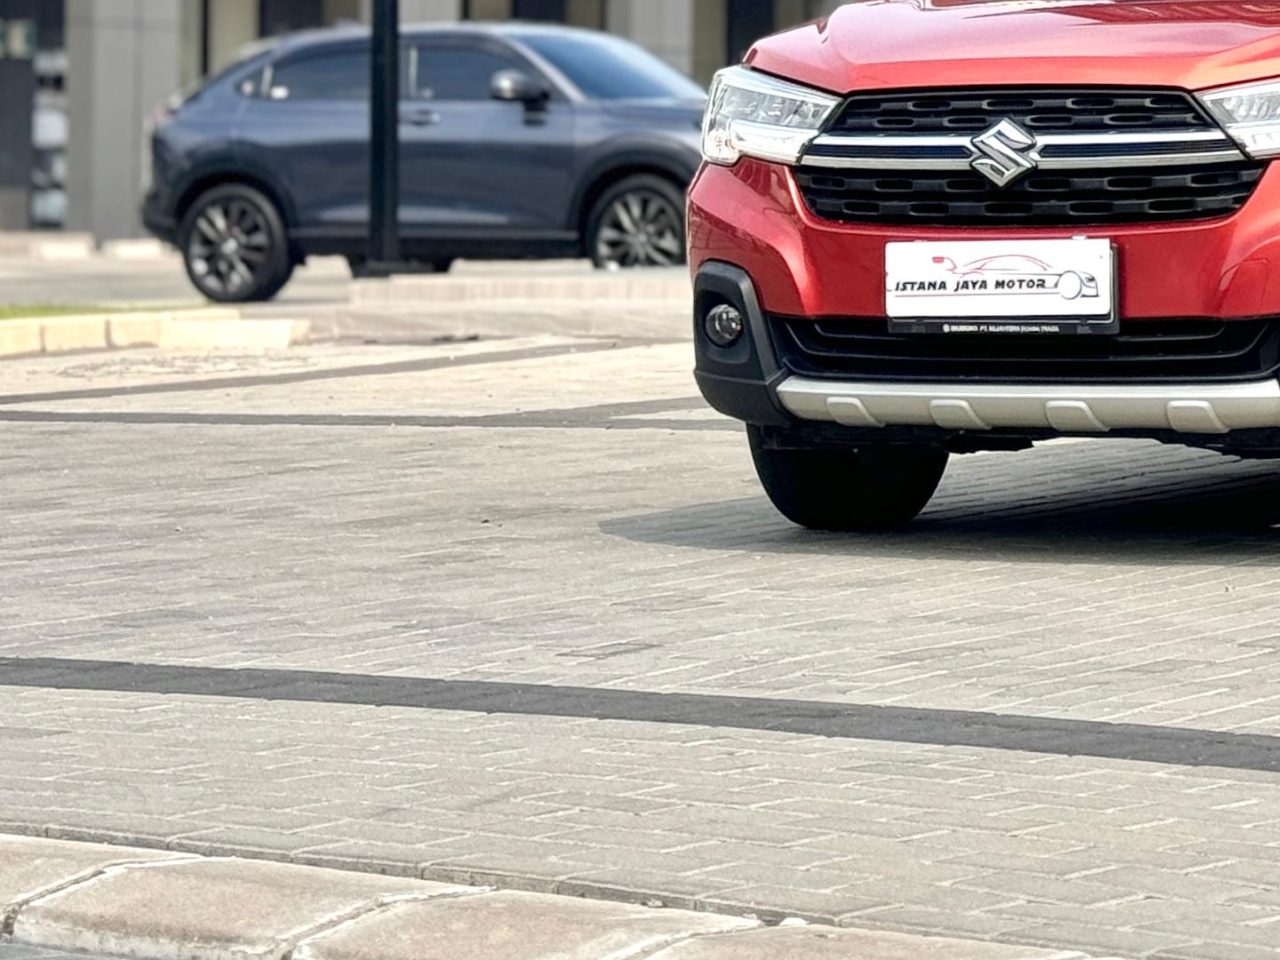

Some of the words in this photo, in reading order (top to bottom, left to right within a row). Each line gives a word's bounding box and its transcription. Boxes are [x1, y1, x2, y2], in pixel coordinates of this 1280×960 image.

[895, 280, 947, 292] ISTANA
[954, 279, 987, 292] JAYA
[995, 278, 1047, 290] MOTOR
